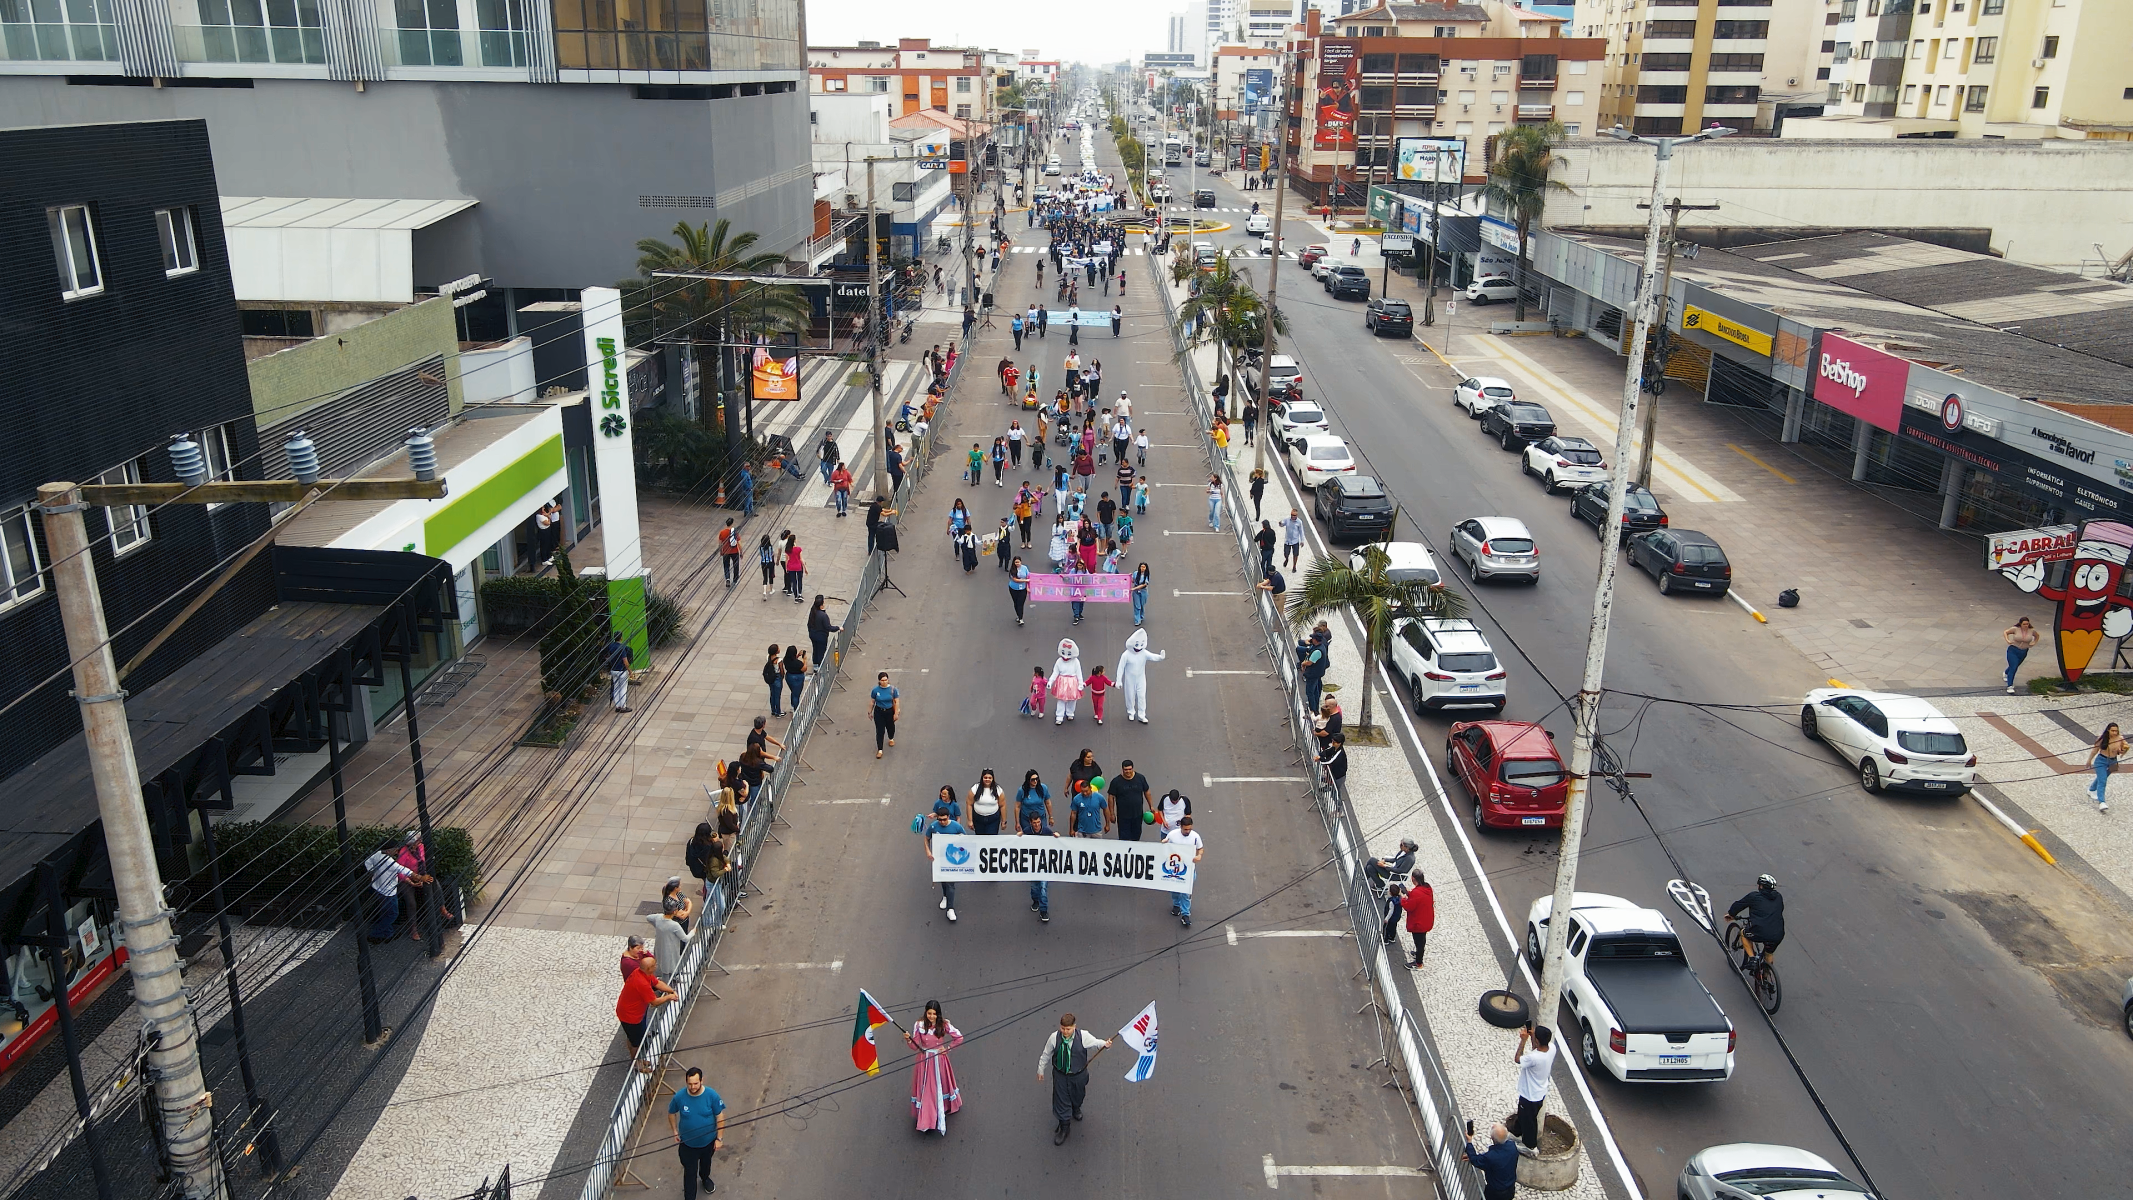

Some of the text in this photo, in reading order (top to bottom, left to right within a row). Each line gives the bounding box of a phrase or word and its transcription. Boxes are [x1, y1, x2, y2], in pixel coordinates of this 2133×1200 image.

[596, 337, 621, 409] Sicredi
[1820, 353, 1867, 399] BelShop
[1967, 414, 1992, 432] INFO
[1906, 426, 1941, 448] COMPUTADORES
[2031, 427, 2068, 448] A tecnologia
[2049, 442, 2096, 465] a seu favor!
[2027, 466, 2064, 487] INFORMÁTICA
[2025, 477, 2064, 498] SUPRIMENTOS
[2076, 486, 2118, 509] ELETRÔNICOS
[2074, 497, 2095, 511] GAMES
[2006, 534, 2073, 555] CABRAL
[979, 847, 1155, 881] SECRETARIA DA SAÚDE
